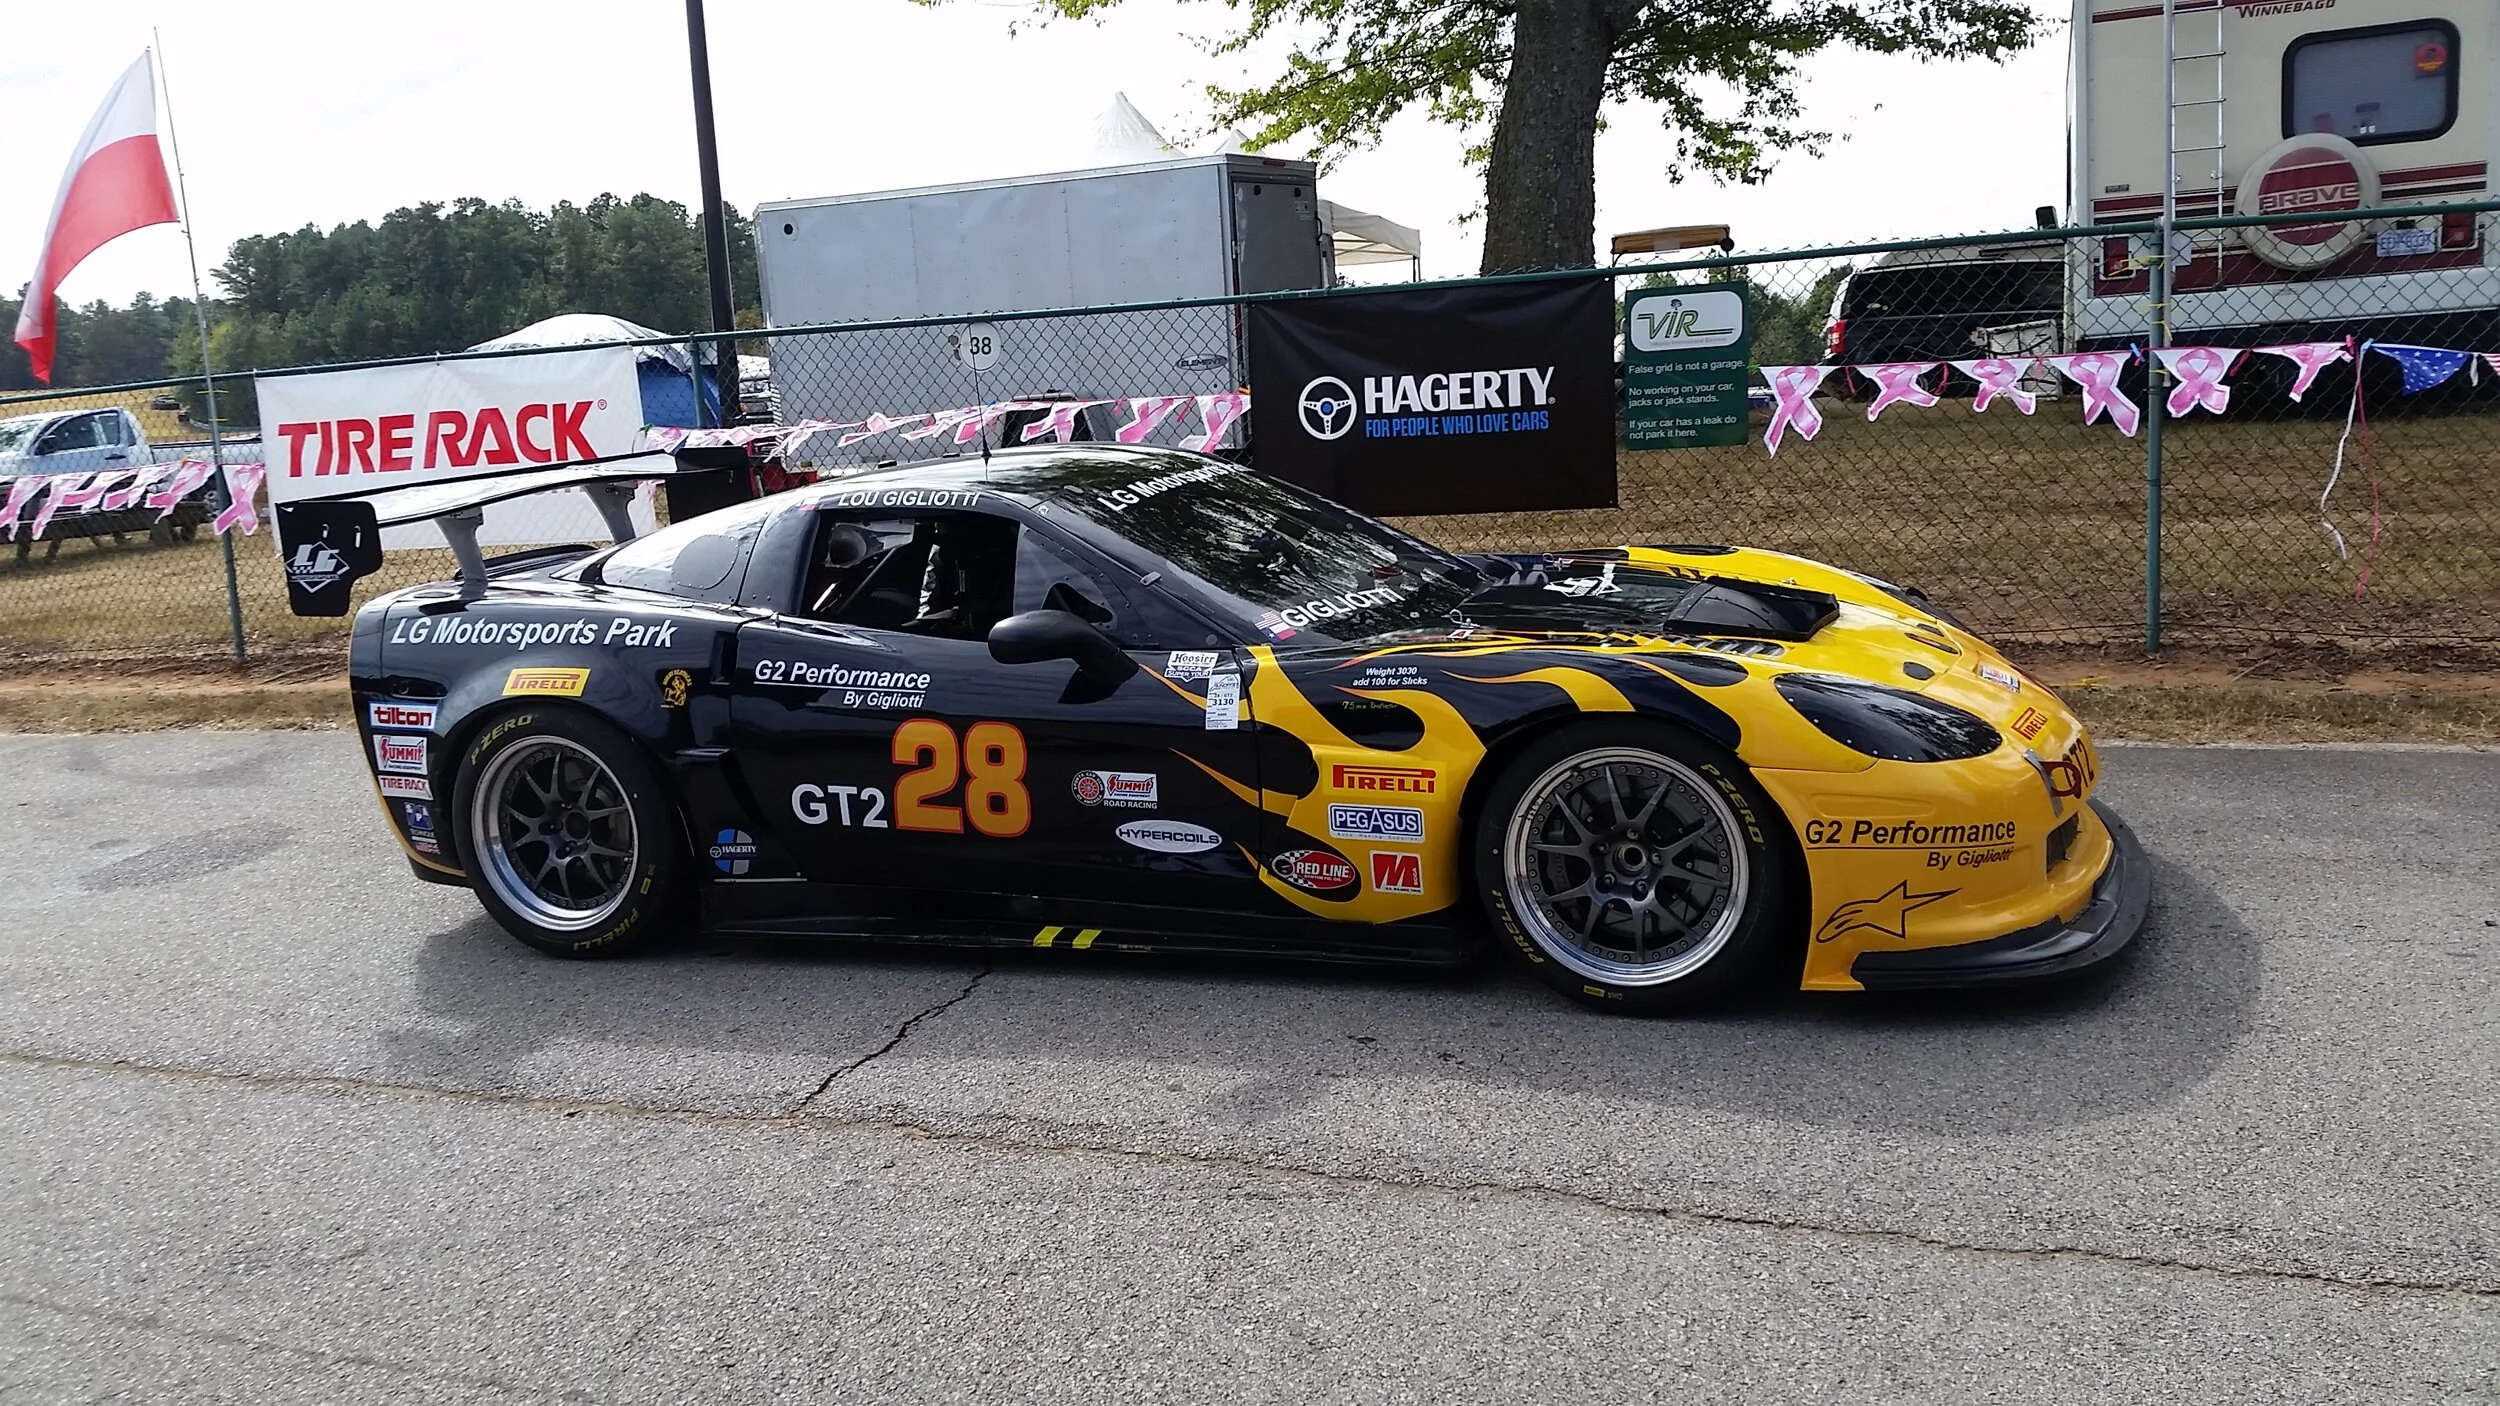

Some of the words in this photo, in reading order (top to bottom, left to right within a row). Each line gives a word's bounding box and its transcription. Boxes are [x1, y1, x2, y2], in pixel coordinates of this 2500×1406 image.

[2235, 0, 2336, 18] WINNEBAGO
[970, 336, 991, 355] 38
[1628, 365, 1653, 374] False
[1655, 363, 1673, 374] grid
[1675, 363, 1683, 371] is
[1685, 361, 1700, 371] not
[1710, 360, 1745, 371] garage.
[1364, 366, 1555, 414] HAGERTY
[1628, 387, 1642, 396] No
[1644, 385, 1679, 396] working
[1695, 384, 1715, 394] your
[1628, 398, 1652, 409] jacks
[1665, 396, 1685, 407] jack
[1686, 394, 1719, 403] stands.
[1365, 419, 1390, 438] FOR
[1392, 416, 1440, 437] PEOPLE
[1441, 414, 1474, 434] WHO
[1476, 412, 1509, 433] LOVE
[1512, 410, 1549, 431] CARS
[1629, 420, 1636, 428] If
[1637, 420, 1658, 430] your
[1676, 417, 1693, 426] has
[1703, 416, 1722, 424] leak
[1724, 415, 1737, 423] do
[278, 414, 415, 478] TIRE
[423, 400, 599, 470] RACK
[1629, 431, 1644, 440] not
[1645, 430, 1665, 441] park
[1667, 429, 1673, 437] it
[1675, 428, 1698, 437] here.
[838, 491, 880, 507] LOU
[882, 490, 981, 507] GIGLIOTTI
[1097, 489, 1140, 512] LG
[293, 544, 340, 573] LG
[1280, 587, 1406, 628] GIGLIOTTI
[390, 617, 430, 645] LG
[431, 616, 600, 651] Motorsports
[603, 617, 679, 648] Park
[510, 673, 582, 691] PIRELLI
[754, 659, 784, 681] G2
[789, 661, 931, 689] Performance
[1352, 678, 1370, 686] add
[1371, 678, 1386, 686] 100
[1387, 677, 1401, 685] for
[1401, 677, 1428, 685] Slicks
[1366, 667, 1396, 677] Weight
[1397, 667, 1418, 675] 3030
[843, 691, 865, 708] By
[866, 692, 925, 709] Gigliotti
[1212, 698, 1234, 706] 3130
[374, 705, 432, 726] tilton
[2010, 706, 2048, 741] PIRELLI
[469, 746, 480, 766] P
[480, 714, 533, 751] ZERO
[381, 777, 403, 789] TIRE
[404, 779, 427, 791] RACK
[891, 718, 1032, 838] 28
[1332, 765, 1436, 793] PIRELLI
[791, 783, 889, 829] GT2
[1103, 800, 1126, 808] ROAD
[1127, 801, 1157, 809] RACING
[1700, 763, 1720, 777] P
[1714, 775, 1765, 845] ZERO
[1335, 808, 1418, 831] PEGASUS
[1118, 828, 1220, 844] HYPERCOILS
[1805, 819, 1843, 845] G2
[1851, 819, 2016, 846] Performance
[722, 845, 756, 853] HAGERTY
[1927, 851, 1952, 871] By
[1957, 847, 2013, 869] Gigliotti
[1296, 862, 1320, 875] RED
[1323, 863, 1350, 878] LINE
[572, 907, 639, 950] PIRELLI
[1491, 889, 1545, 965] PIRELLI
